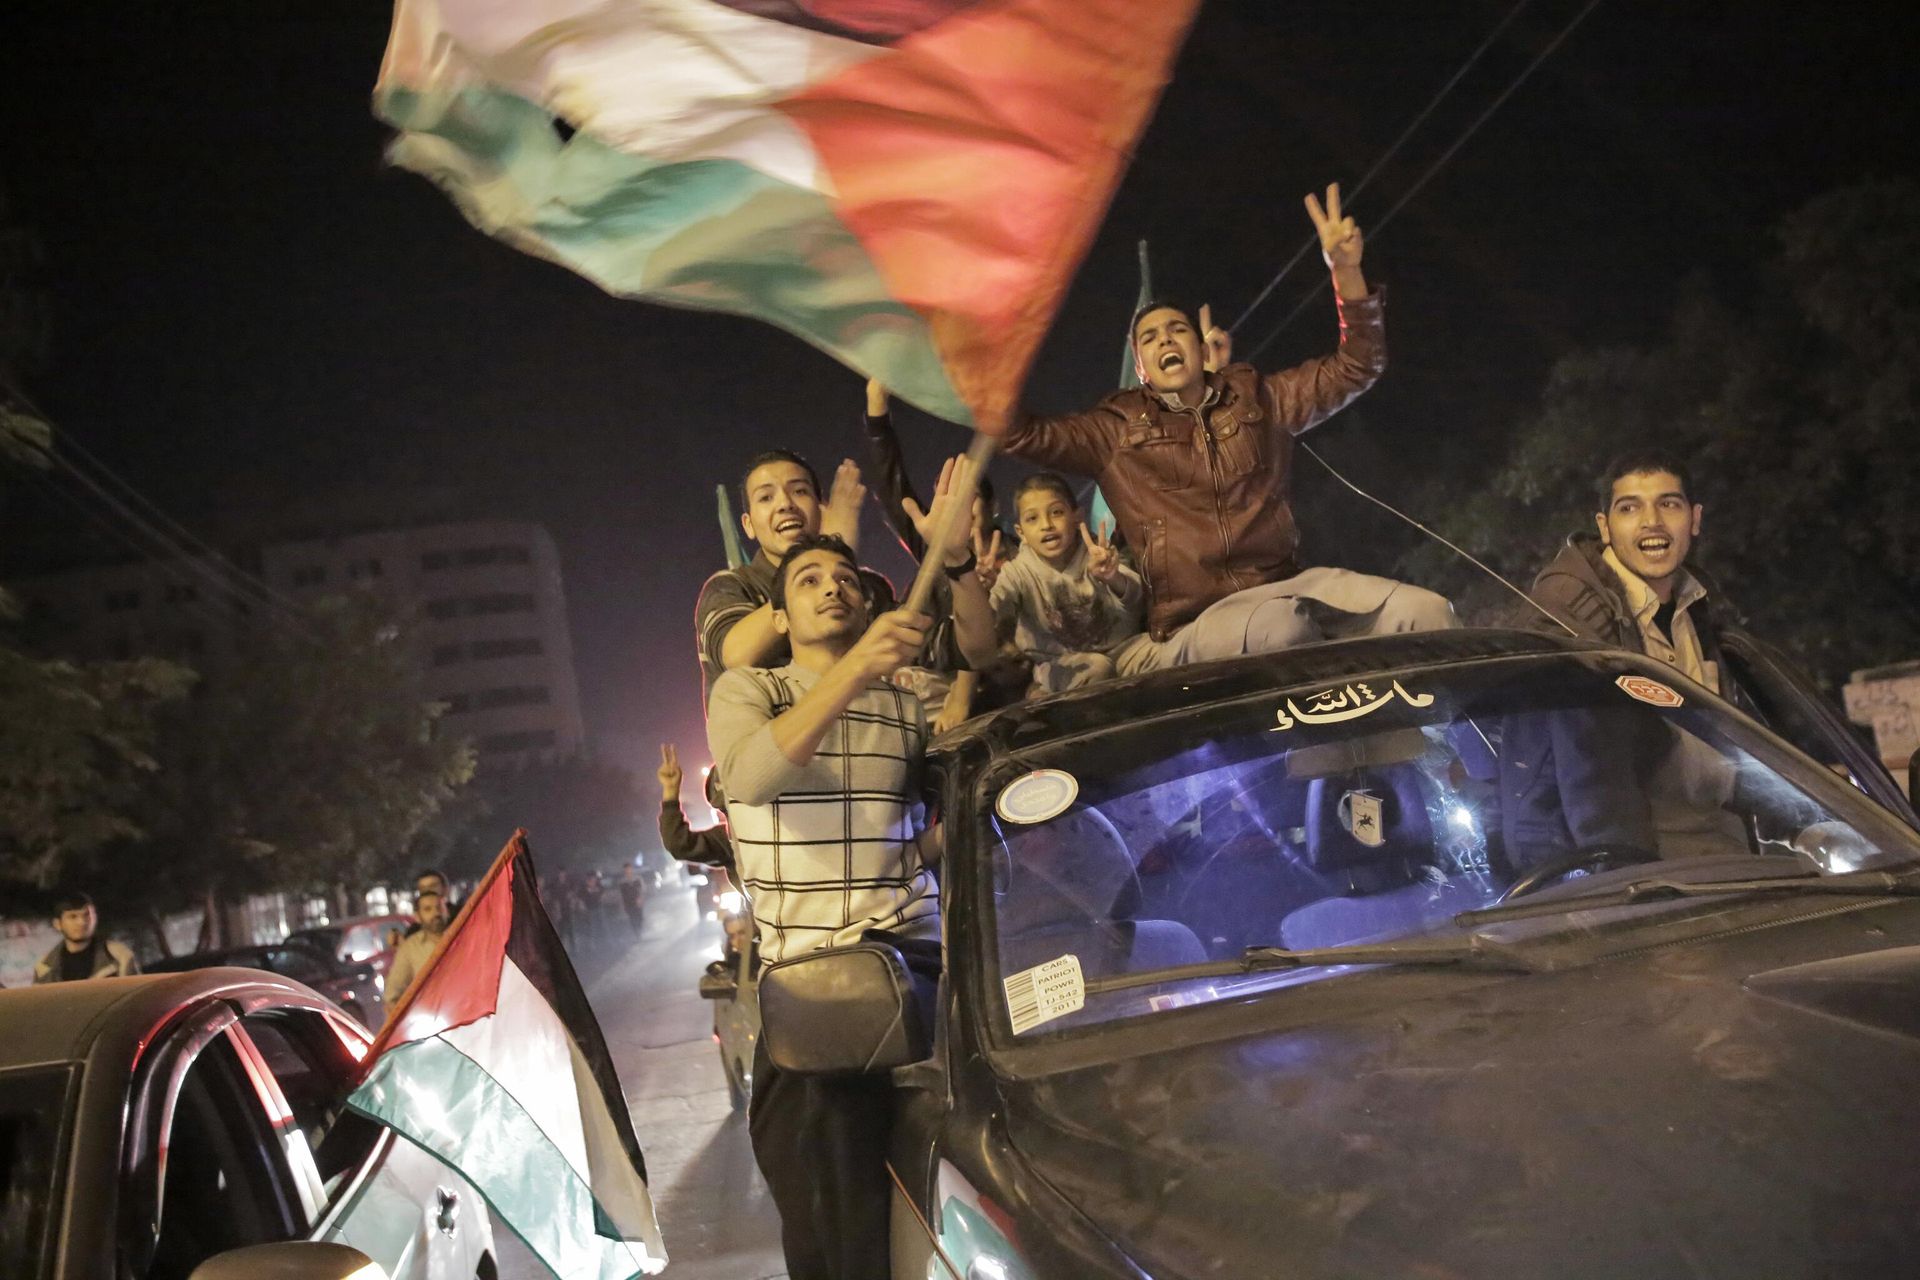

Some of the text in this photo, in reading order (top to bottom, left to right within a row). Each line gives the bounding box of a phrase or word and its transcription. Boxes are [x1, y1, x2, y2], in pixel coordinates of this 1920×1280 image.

[1393, 679, 1435, 708] ما
[1041, 959, 1068, 972] CARS
[1038, 967, 1076, 985] PATRIOT
[1044, 979, 1074, 994] POWR
